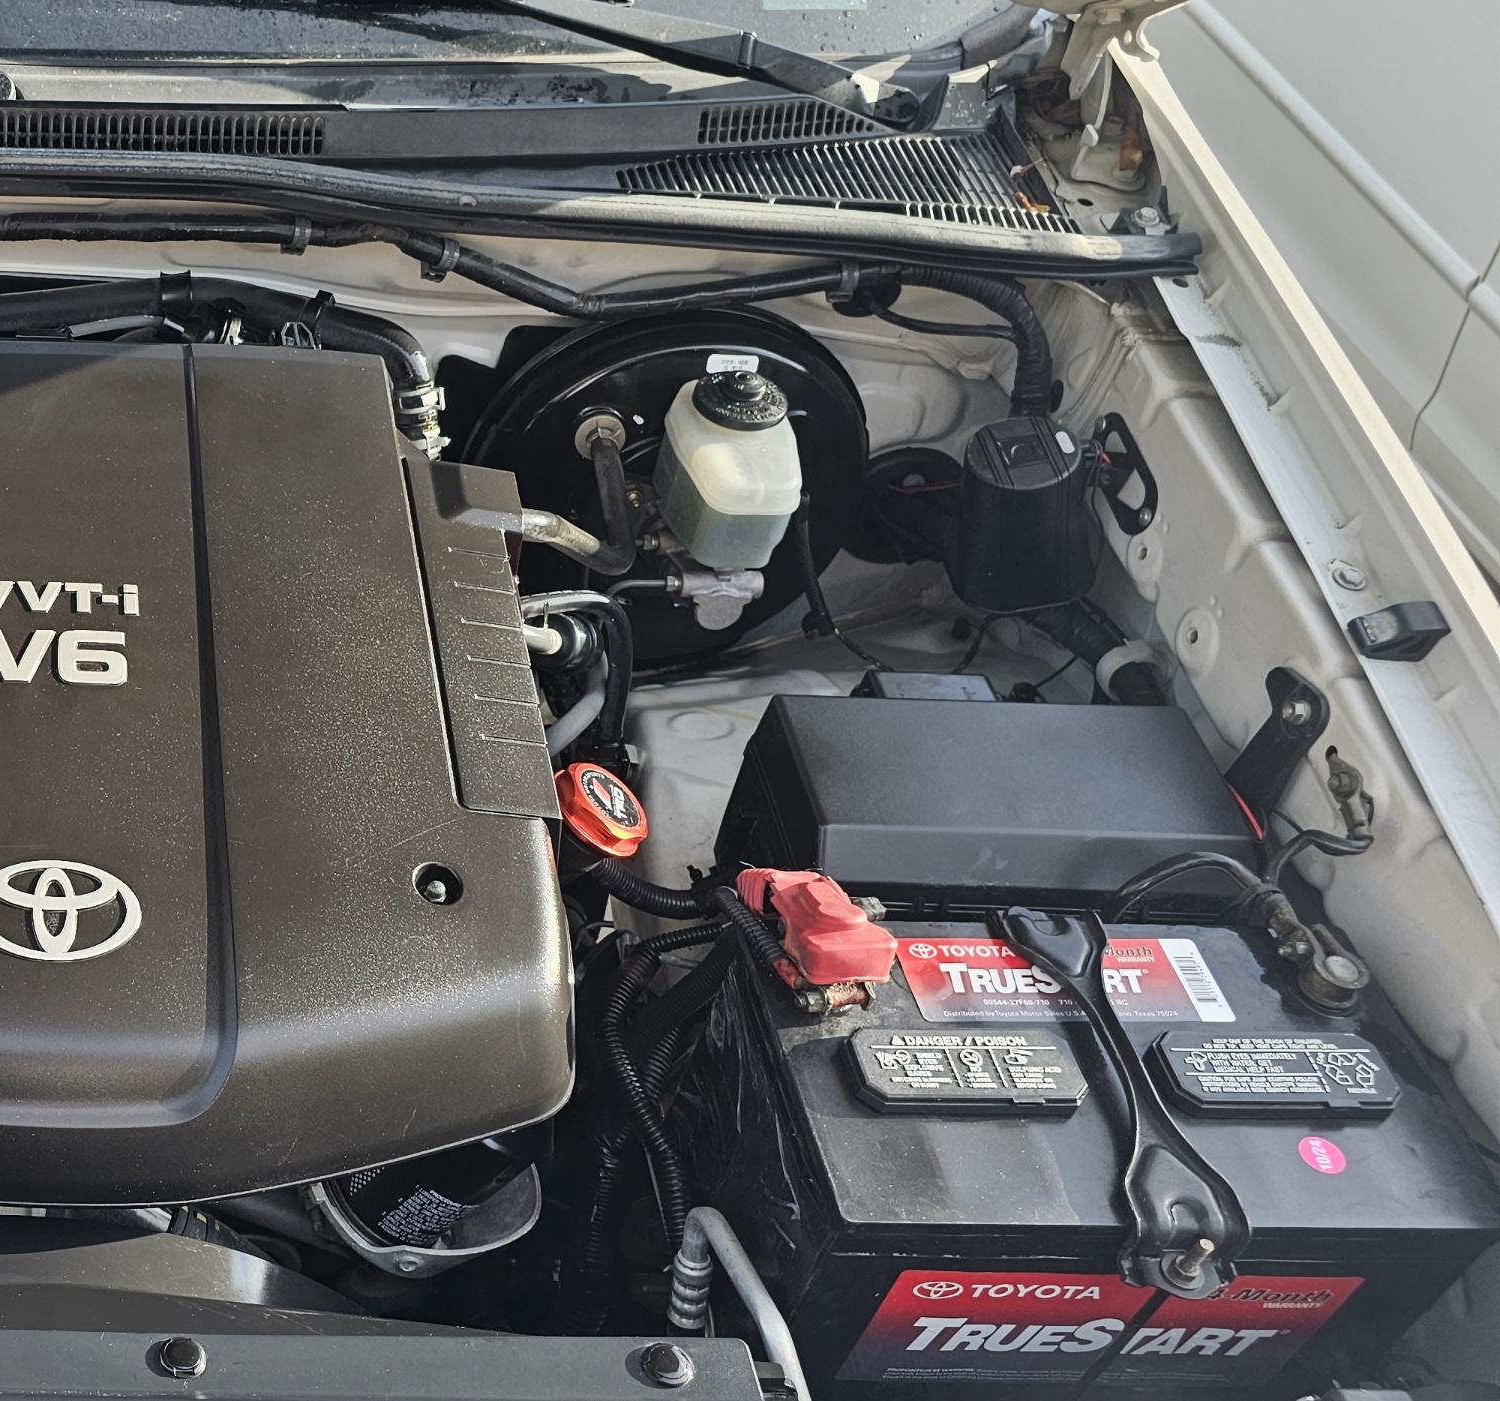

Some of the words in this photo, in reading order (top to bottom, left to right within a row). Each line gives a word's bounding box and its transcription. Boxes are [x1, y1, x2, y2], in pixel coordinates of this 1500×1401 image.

[937, 945, 1016, 958] TOYOTA
[939, 962, 1143, 994] TRUESRT
[994, 1010, 1020, 1018] Toyota
[903, 1036, 963, 1046] DANGER
[974, 1036, 1028, 1046] POISON
[1308, 1140, 1334, 1171] 10/24
[971, 1284, 1100, 1299] TOYOTA
[905, 1316, 1279, 1356] TRUESTART
